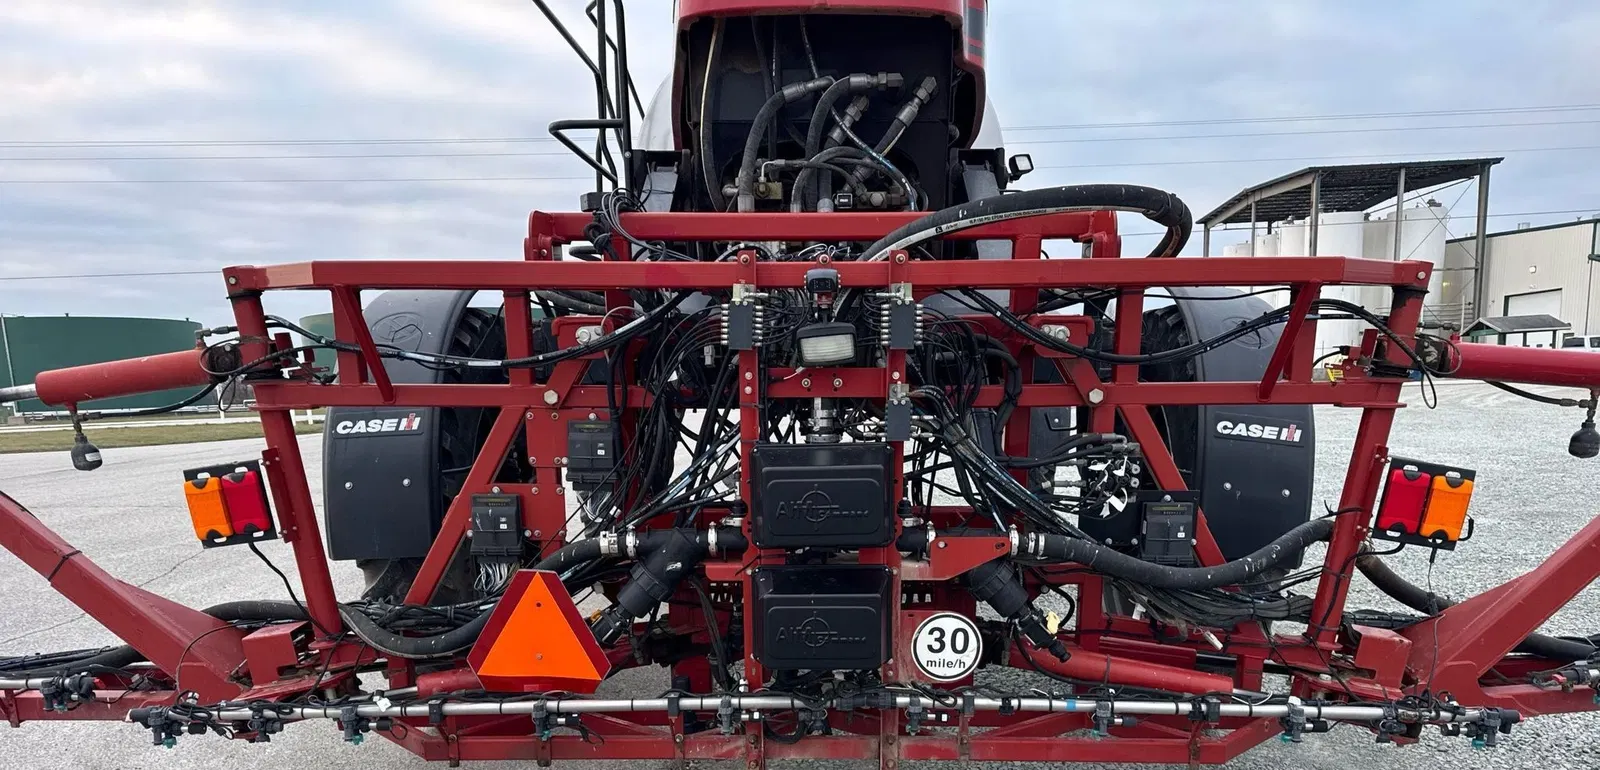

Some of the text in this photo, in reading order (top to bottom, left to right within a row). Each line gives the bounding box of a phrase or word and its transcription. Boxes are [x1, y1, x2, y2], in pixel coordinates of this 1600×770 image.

[336, 418, 399, 434] CASE
[1216, 420, 1280, 440] CASE
[927, 627, 969, 654] 30
[926, 658, 966, 669] mile/h
